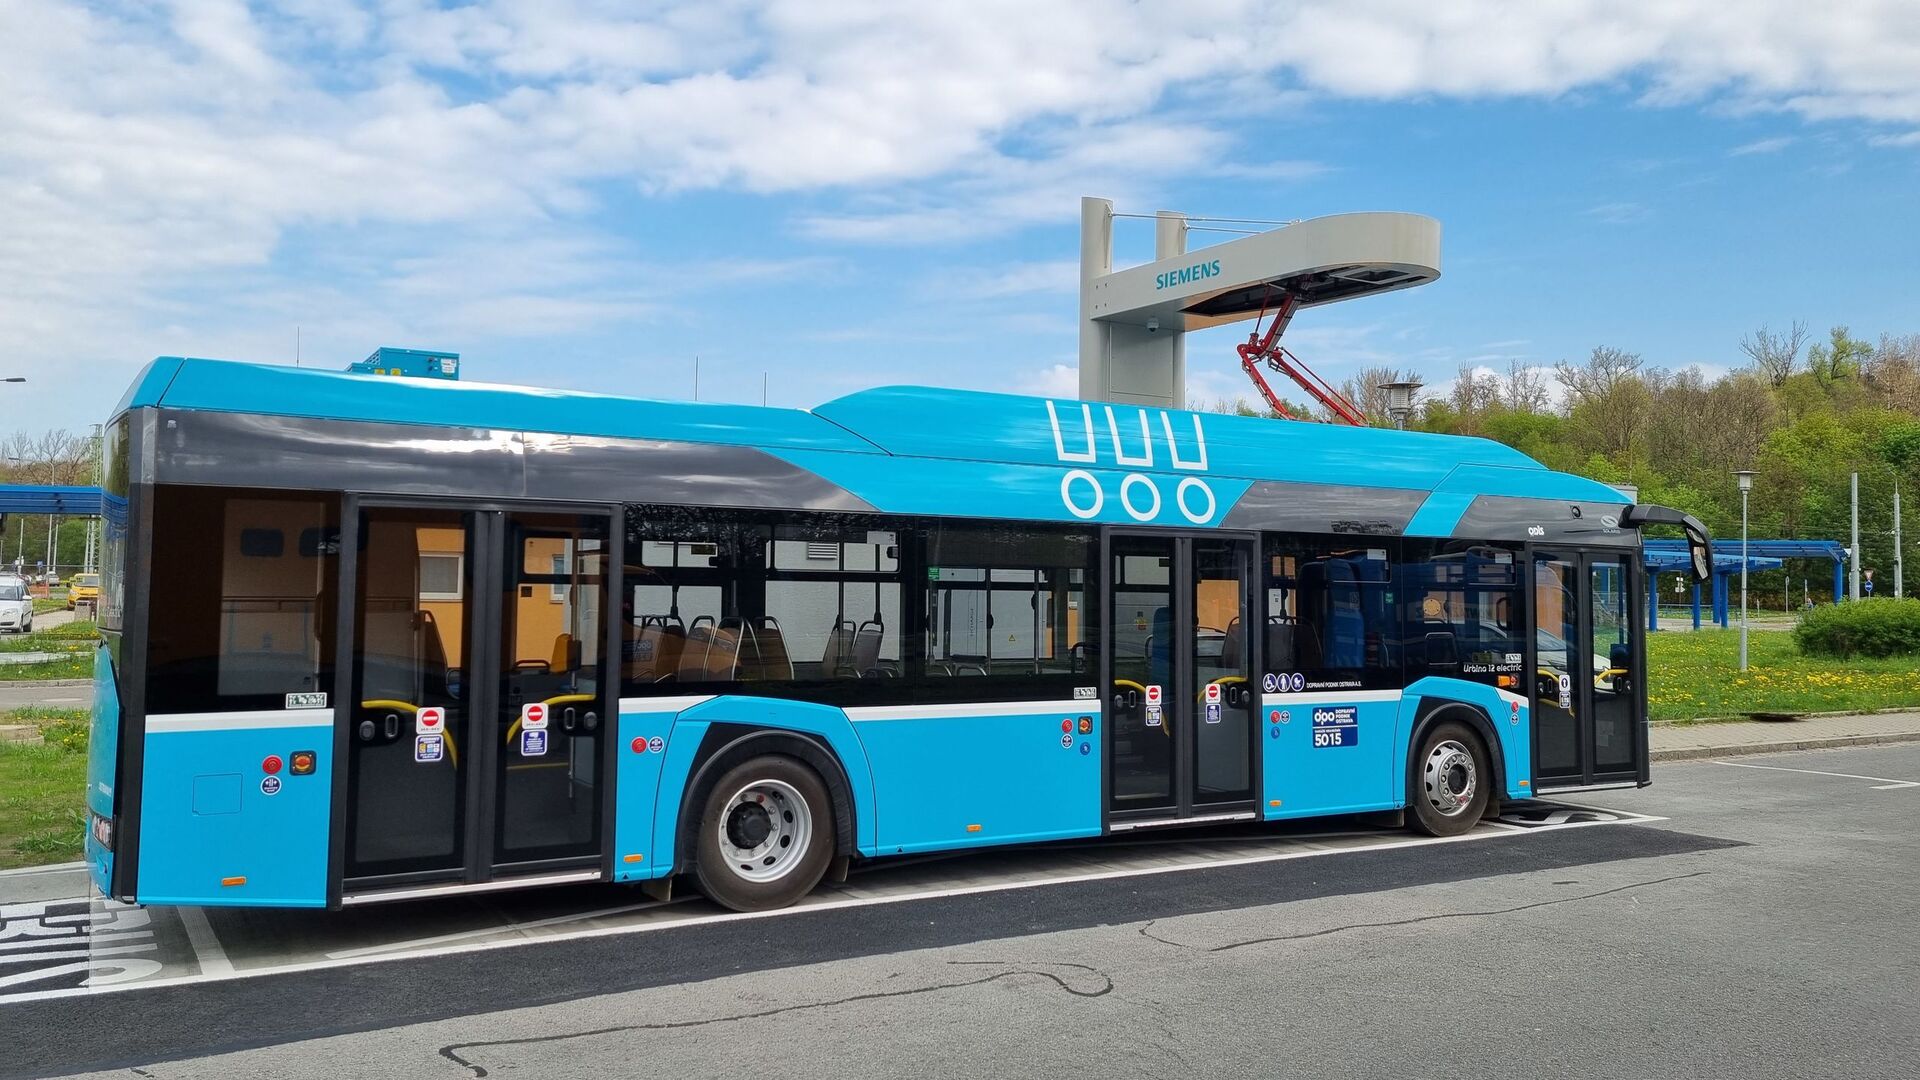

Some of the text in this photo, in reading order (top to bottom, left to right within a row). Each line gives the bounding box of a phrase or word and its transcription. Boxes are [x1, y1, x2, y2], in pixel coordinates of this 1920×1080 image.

[1156, 260, 1220, 290] SIEMENS
[1463, 664, 1522, 673] Urbino 12 electric
[1314, 709, 1335, 725] dpo
[1315, 733, 1342, 746] 5015
